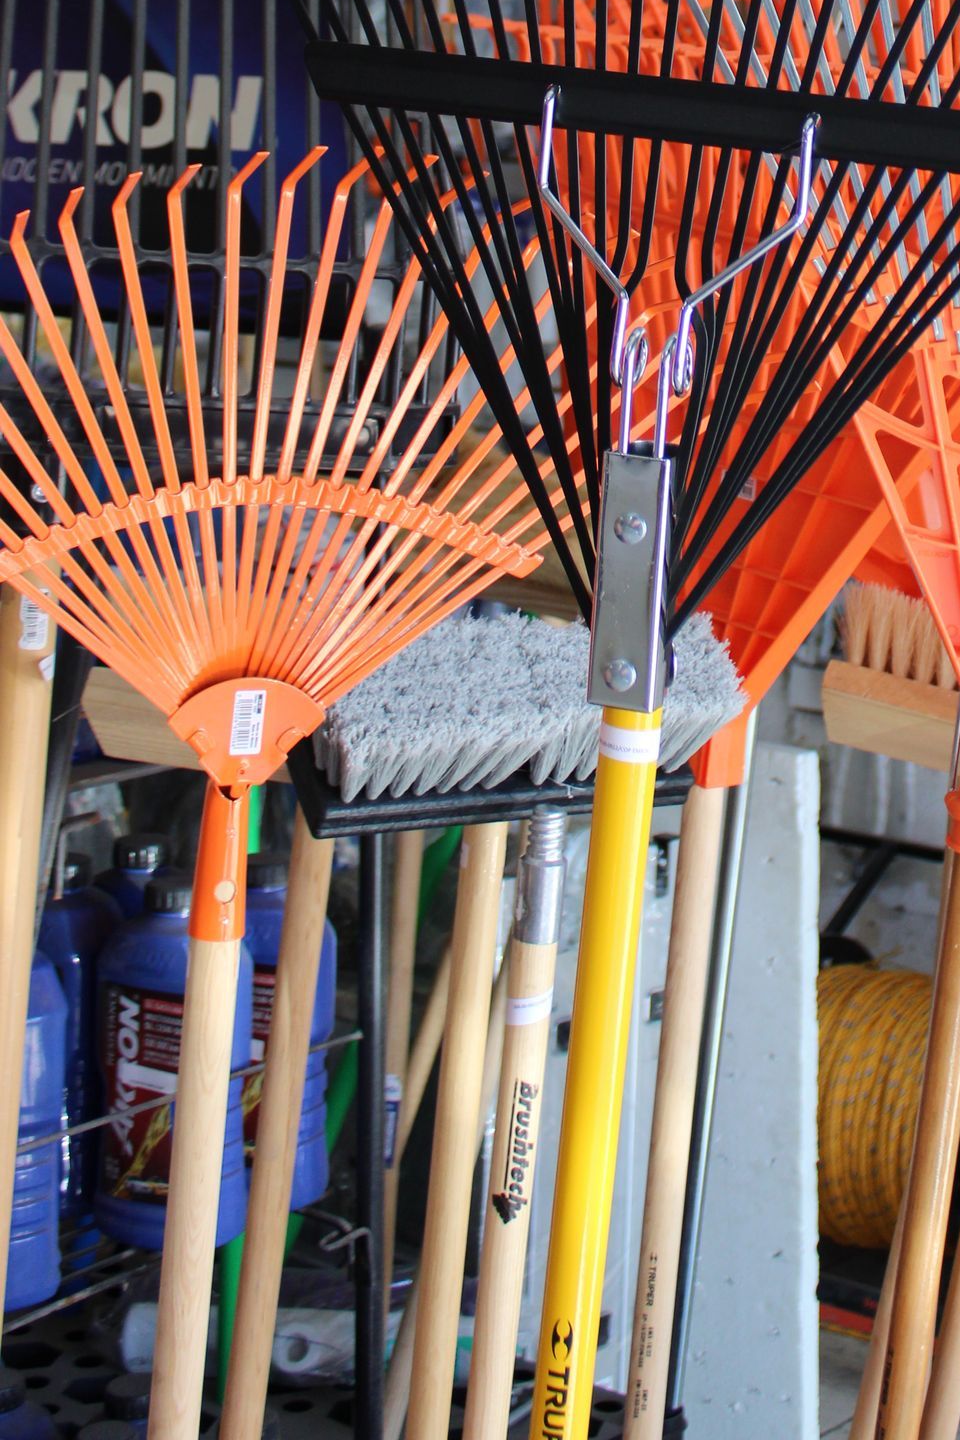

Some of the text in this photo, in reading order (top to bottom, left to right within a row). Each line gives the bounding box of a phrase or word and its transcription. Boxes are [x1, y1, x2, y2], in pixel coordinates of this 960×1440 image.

[112, 995, 141, 1152] AKON
[506, 1080, 540, 1214] Brushtech
[645, 1266, 659, 1307] TRUPER
